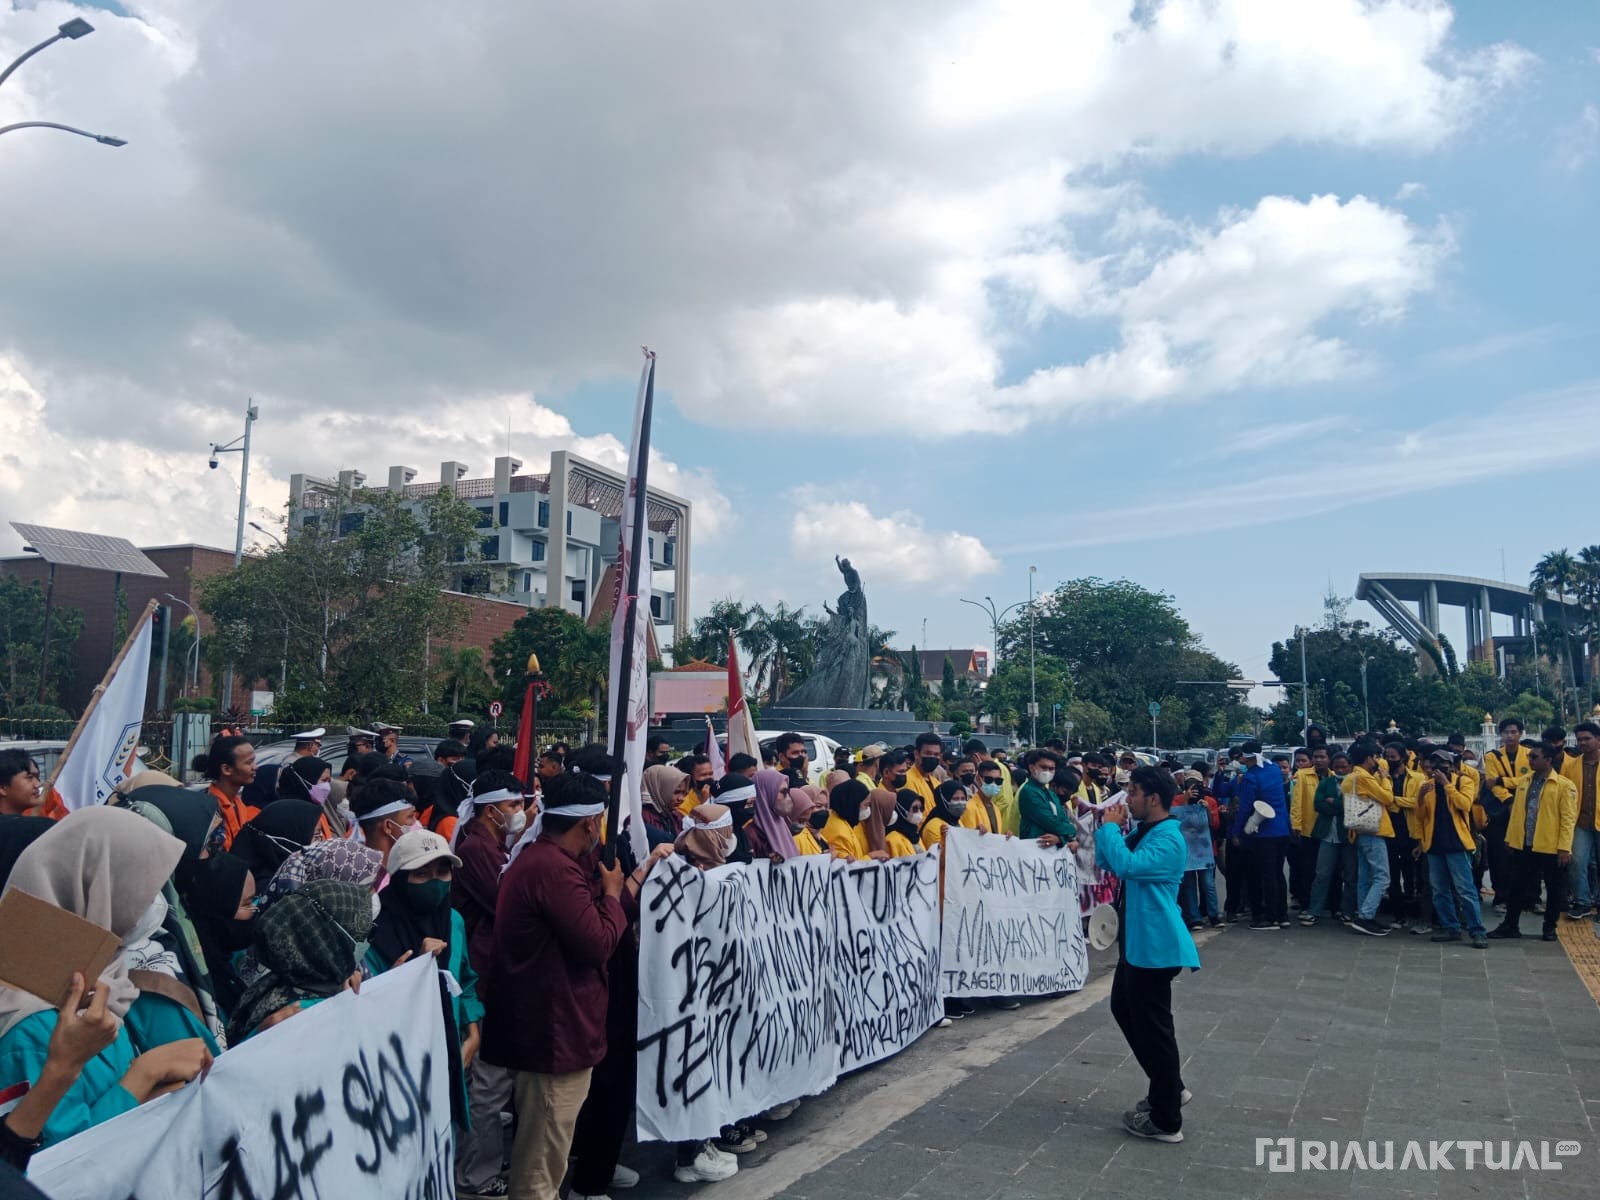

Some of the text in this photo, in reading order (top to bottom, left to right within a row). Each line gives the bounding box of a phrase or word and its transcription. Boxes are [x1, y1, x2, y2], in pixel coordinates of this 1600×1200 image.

[961, 853, 1050, 897] ASAPNYA
[943, 970, 1006, 992] TRAGEDI
[1010, 974, 1020, 992] DI
